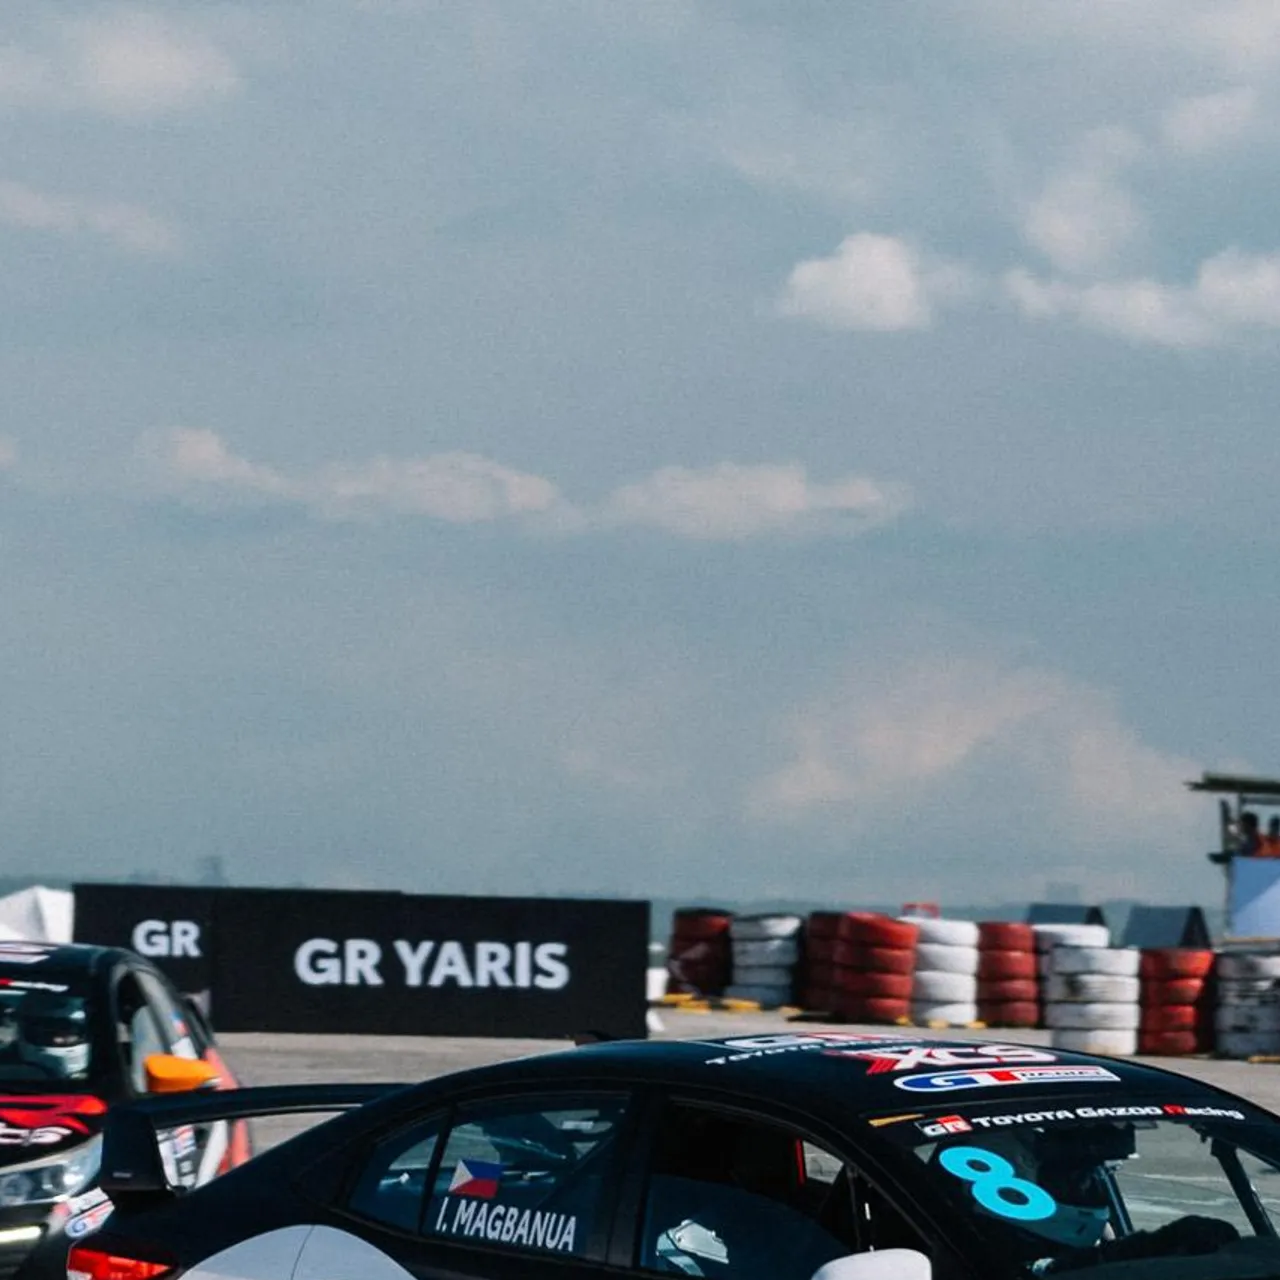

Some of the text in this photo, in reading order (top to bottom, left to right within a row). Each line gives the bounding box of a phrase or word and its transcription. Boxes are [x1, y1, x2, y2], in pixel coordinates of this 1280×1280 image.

[132, 920, 202, 957] GR
[294, 938, 570, 990] GR YARIS
[923, 1104, 1246, 1138] GR TOYOTA GAZOO Racing
[938, 1145, 1057, 1221] 8
[435, 1196, 577, 1252] I. MAGBANUA
